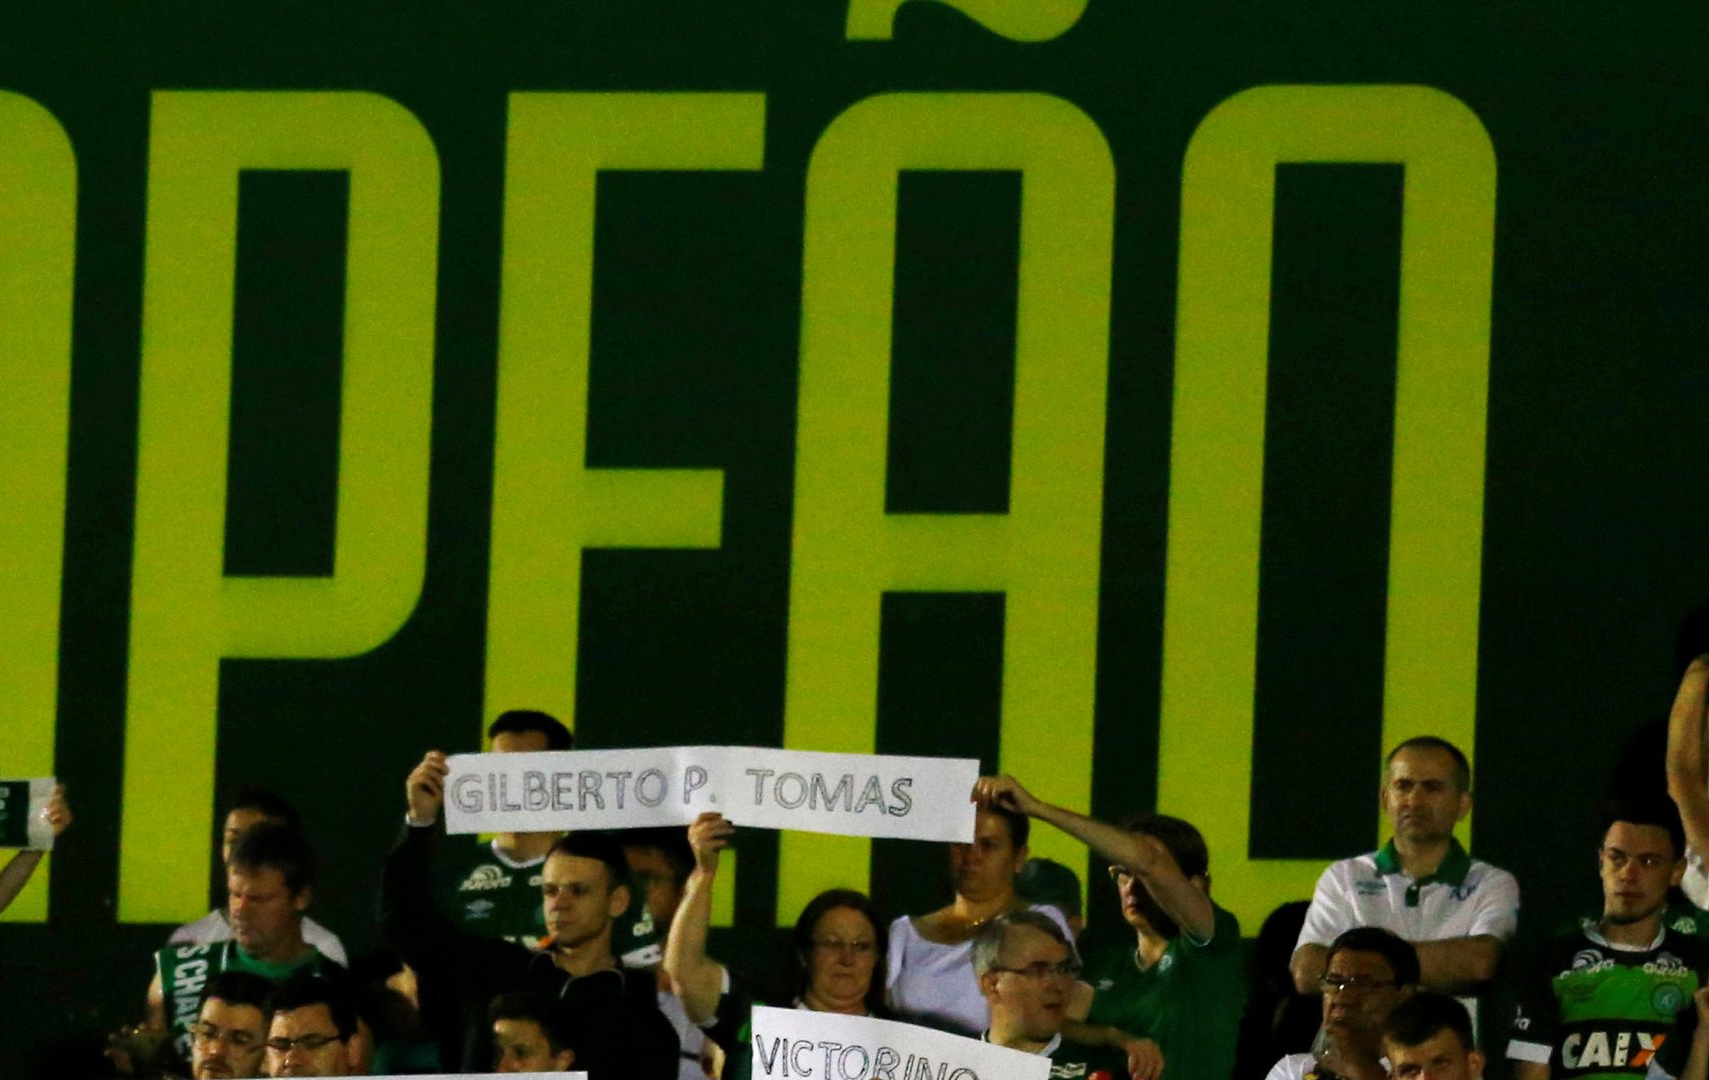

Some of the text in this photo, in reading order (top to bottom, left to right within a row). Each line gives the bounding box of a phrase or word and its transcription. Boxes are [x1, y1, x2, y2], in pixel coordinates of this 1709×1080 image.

[451, 764, 914, 817] GILBERTO P. TOMAS
[1562, 1031, 1667, 1070] CAIX
